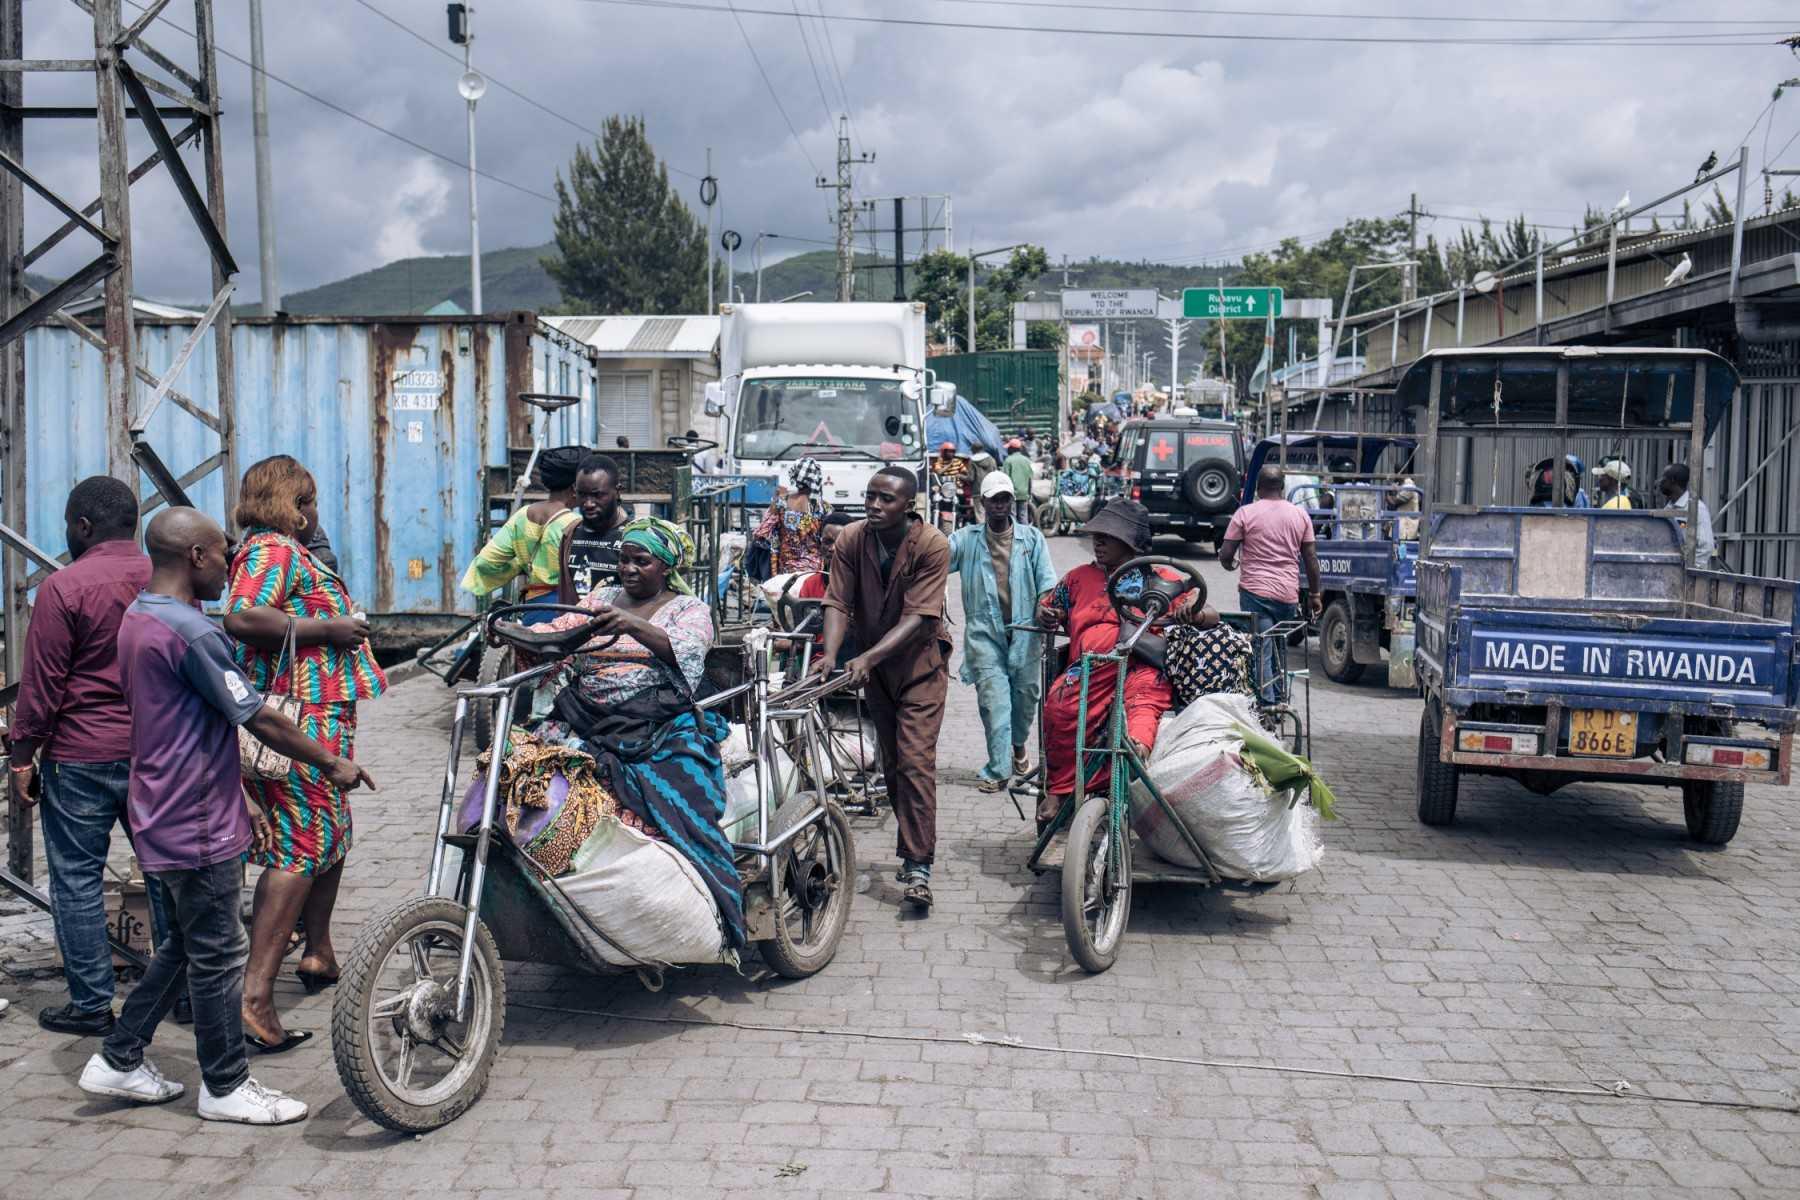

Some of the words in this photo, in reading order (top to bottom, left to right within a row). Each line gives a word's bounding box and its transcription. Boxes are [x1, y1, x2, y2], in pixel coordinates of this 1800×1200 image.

[1091, 291, 1129, 299] WELCOME
[1095, 300, 1105, 308] TO
[1332, 560, 1352, 573] BODY
[1484, 641, 1566, 672] MADE
[1582, 647, 1611, 674] IN
[1626, 649, 1757, 685] RWANDA
[1576, 731, 1627, 753] 866E
[104, 910, 144, 945] effe
